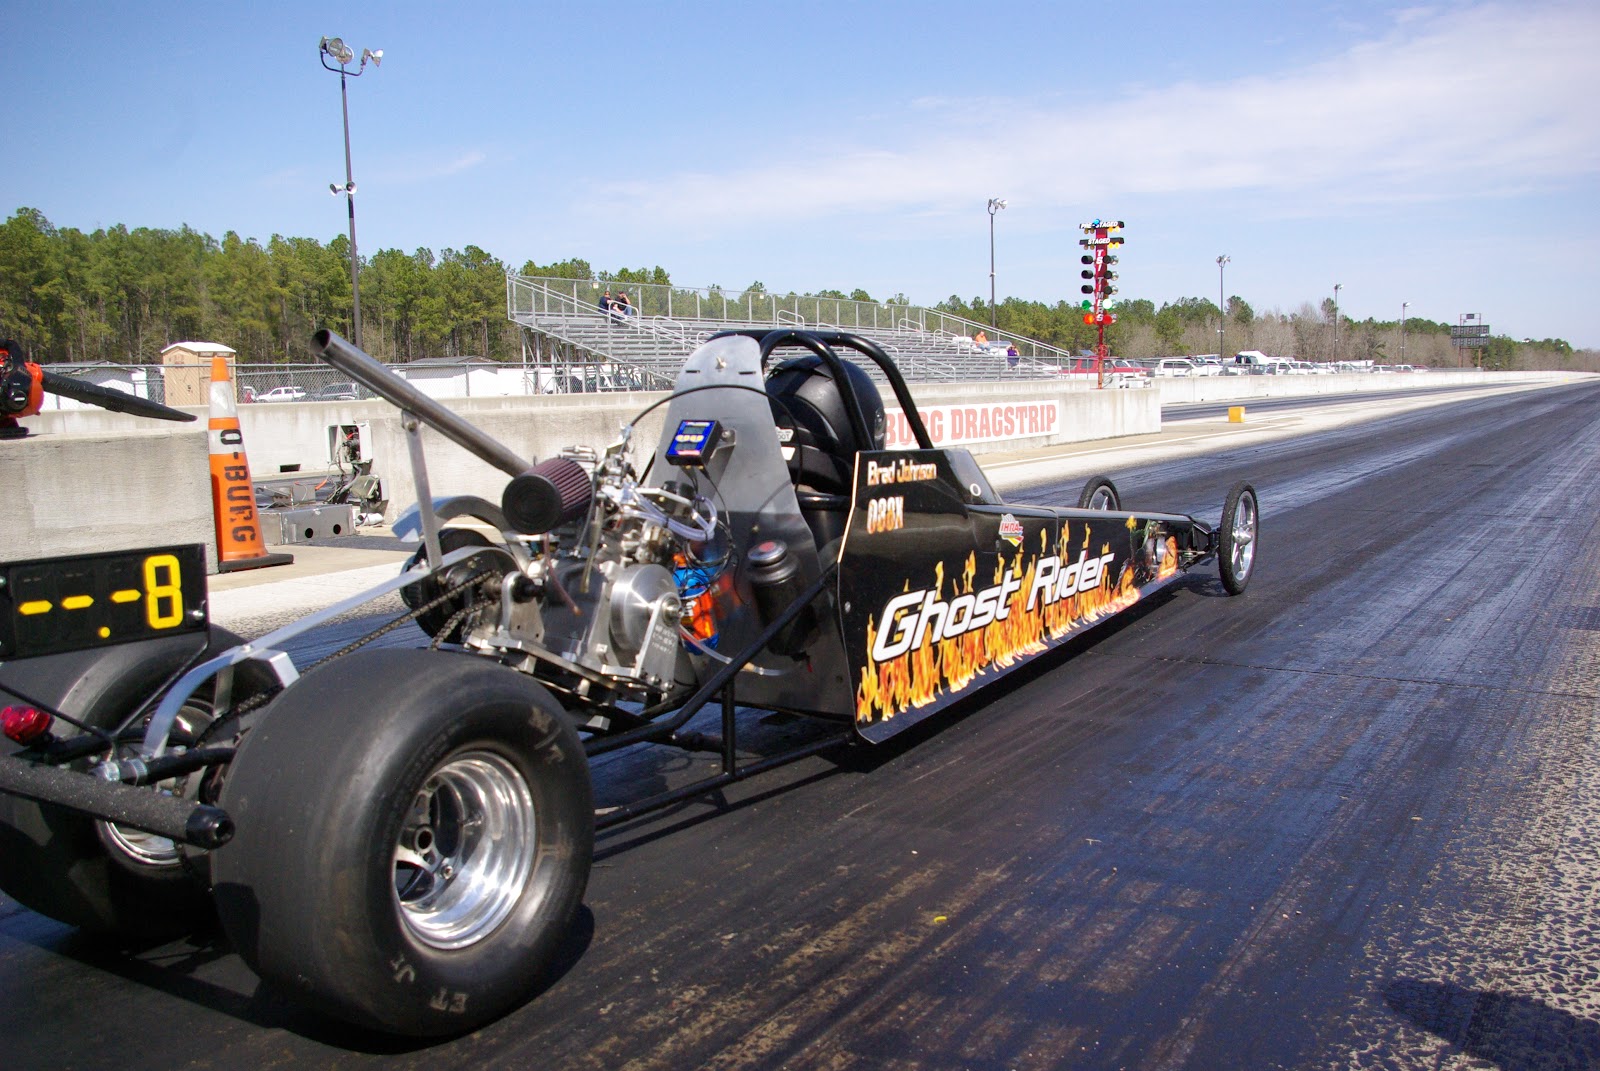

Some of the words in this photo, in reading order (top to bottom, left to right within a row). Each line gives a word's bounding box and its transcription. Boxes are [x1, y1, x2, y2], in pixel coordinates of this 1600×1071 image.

[951, 405, 1057, 439] DRAGSTRIP
[867, 460, 896, 486] Brad
[897, 458, 937, 483] Johnson
[872, 569, 1022, 662] Ghost
[1026, 551, 1115, 612] Rider
